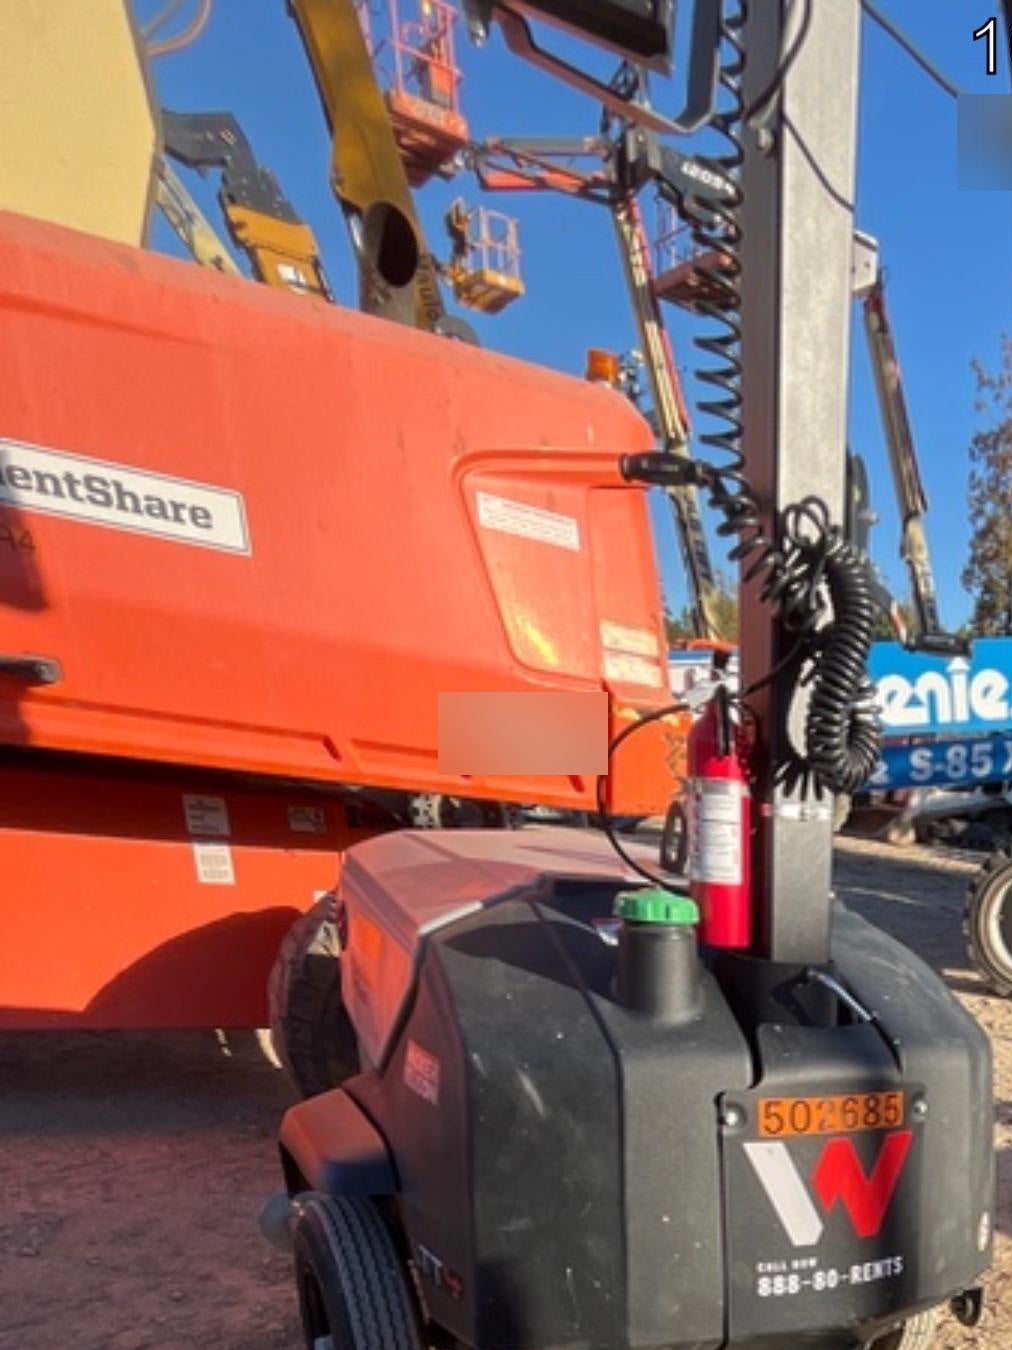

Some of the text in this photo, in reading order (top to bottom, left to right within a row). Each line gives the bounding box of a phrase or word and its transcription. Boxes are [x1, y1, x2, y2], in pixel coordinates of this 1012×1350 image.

[0, 464, 213, 529] entShare
[873, 656, 1010, 724] enie
[909, 743, 993, 781] S-85
[763, 1095, 899, 1134] 502685
